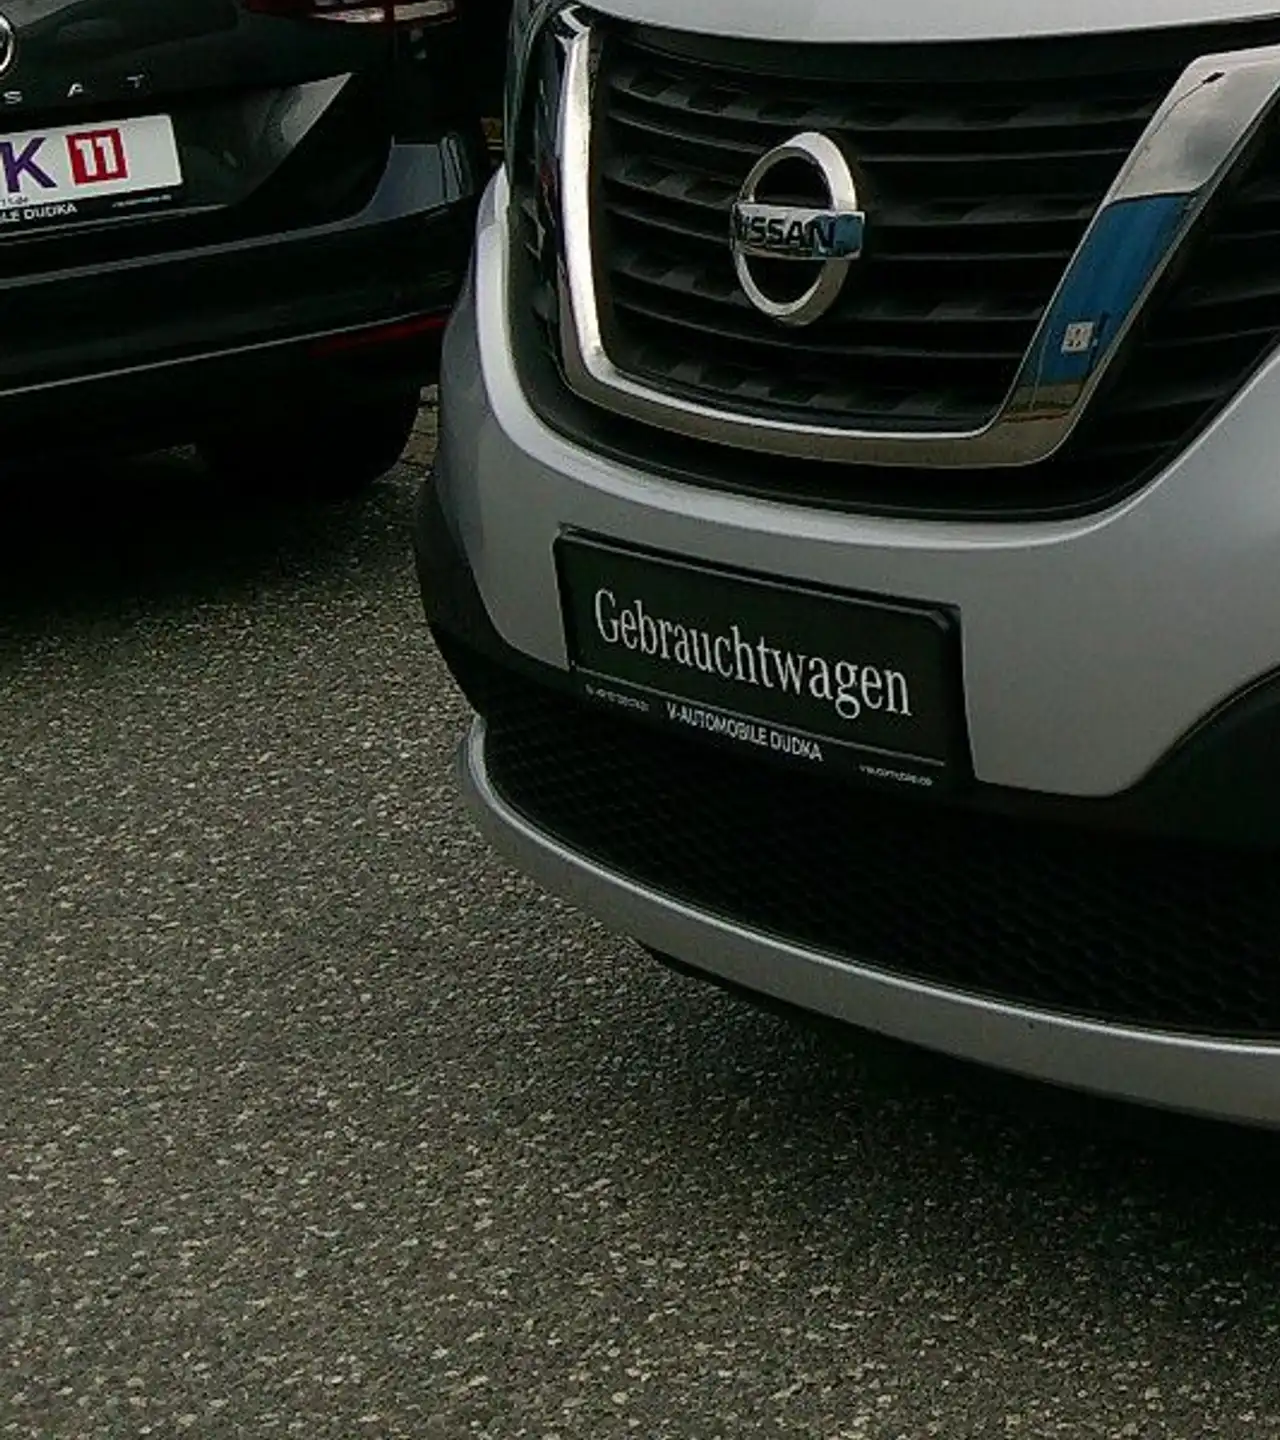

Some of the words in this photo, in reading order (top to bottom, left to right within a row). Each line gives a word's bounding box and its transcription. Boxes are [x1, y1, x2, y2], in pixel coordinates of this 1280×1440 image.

[24, 203, 78, 220] DUDKA
[594, 588, 913, 719] Gebrauchtwagen
[666, 700, 768, 746] V-AUTOMOBILE
[770, 730, 825, 762] DUDKA
